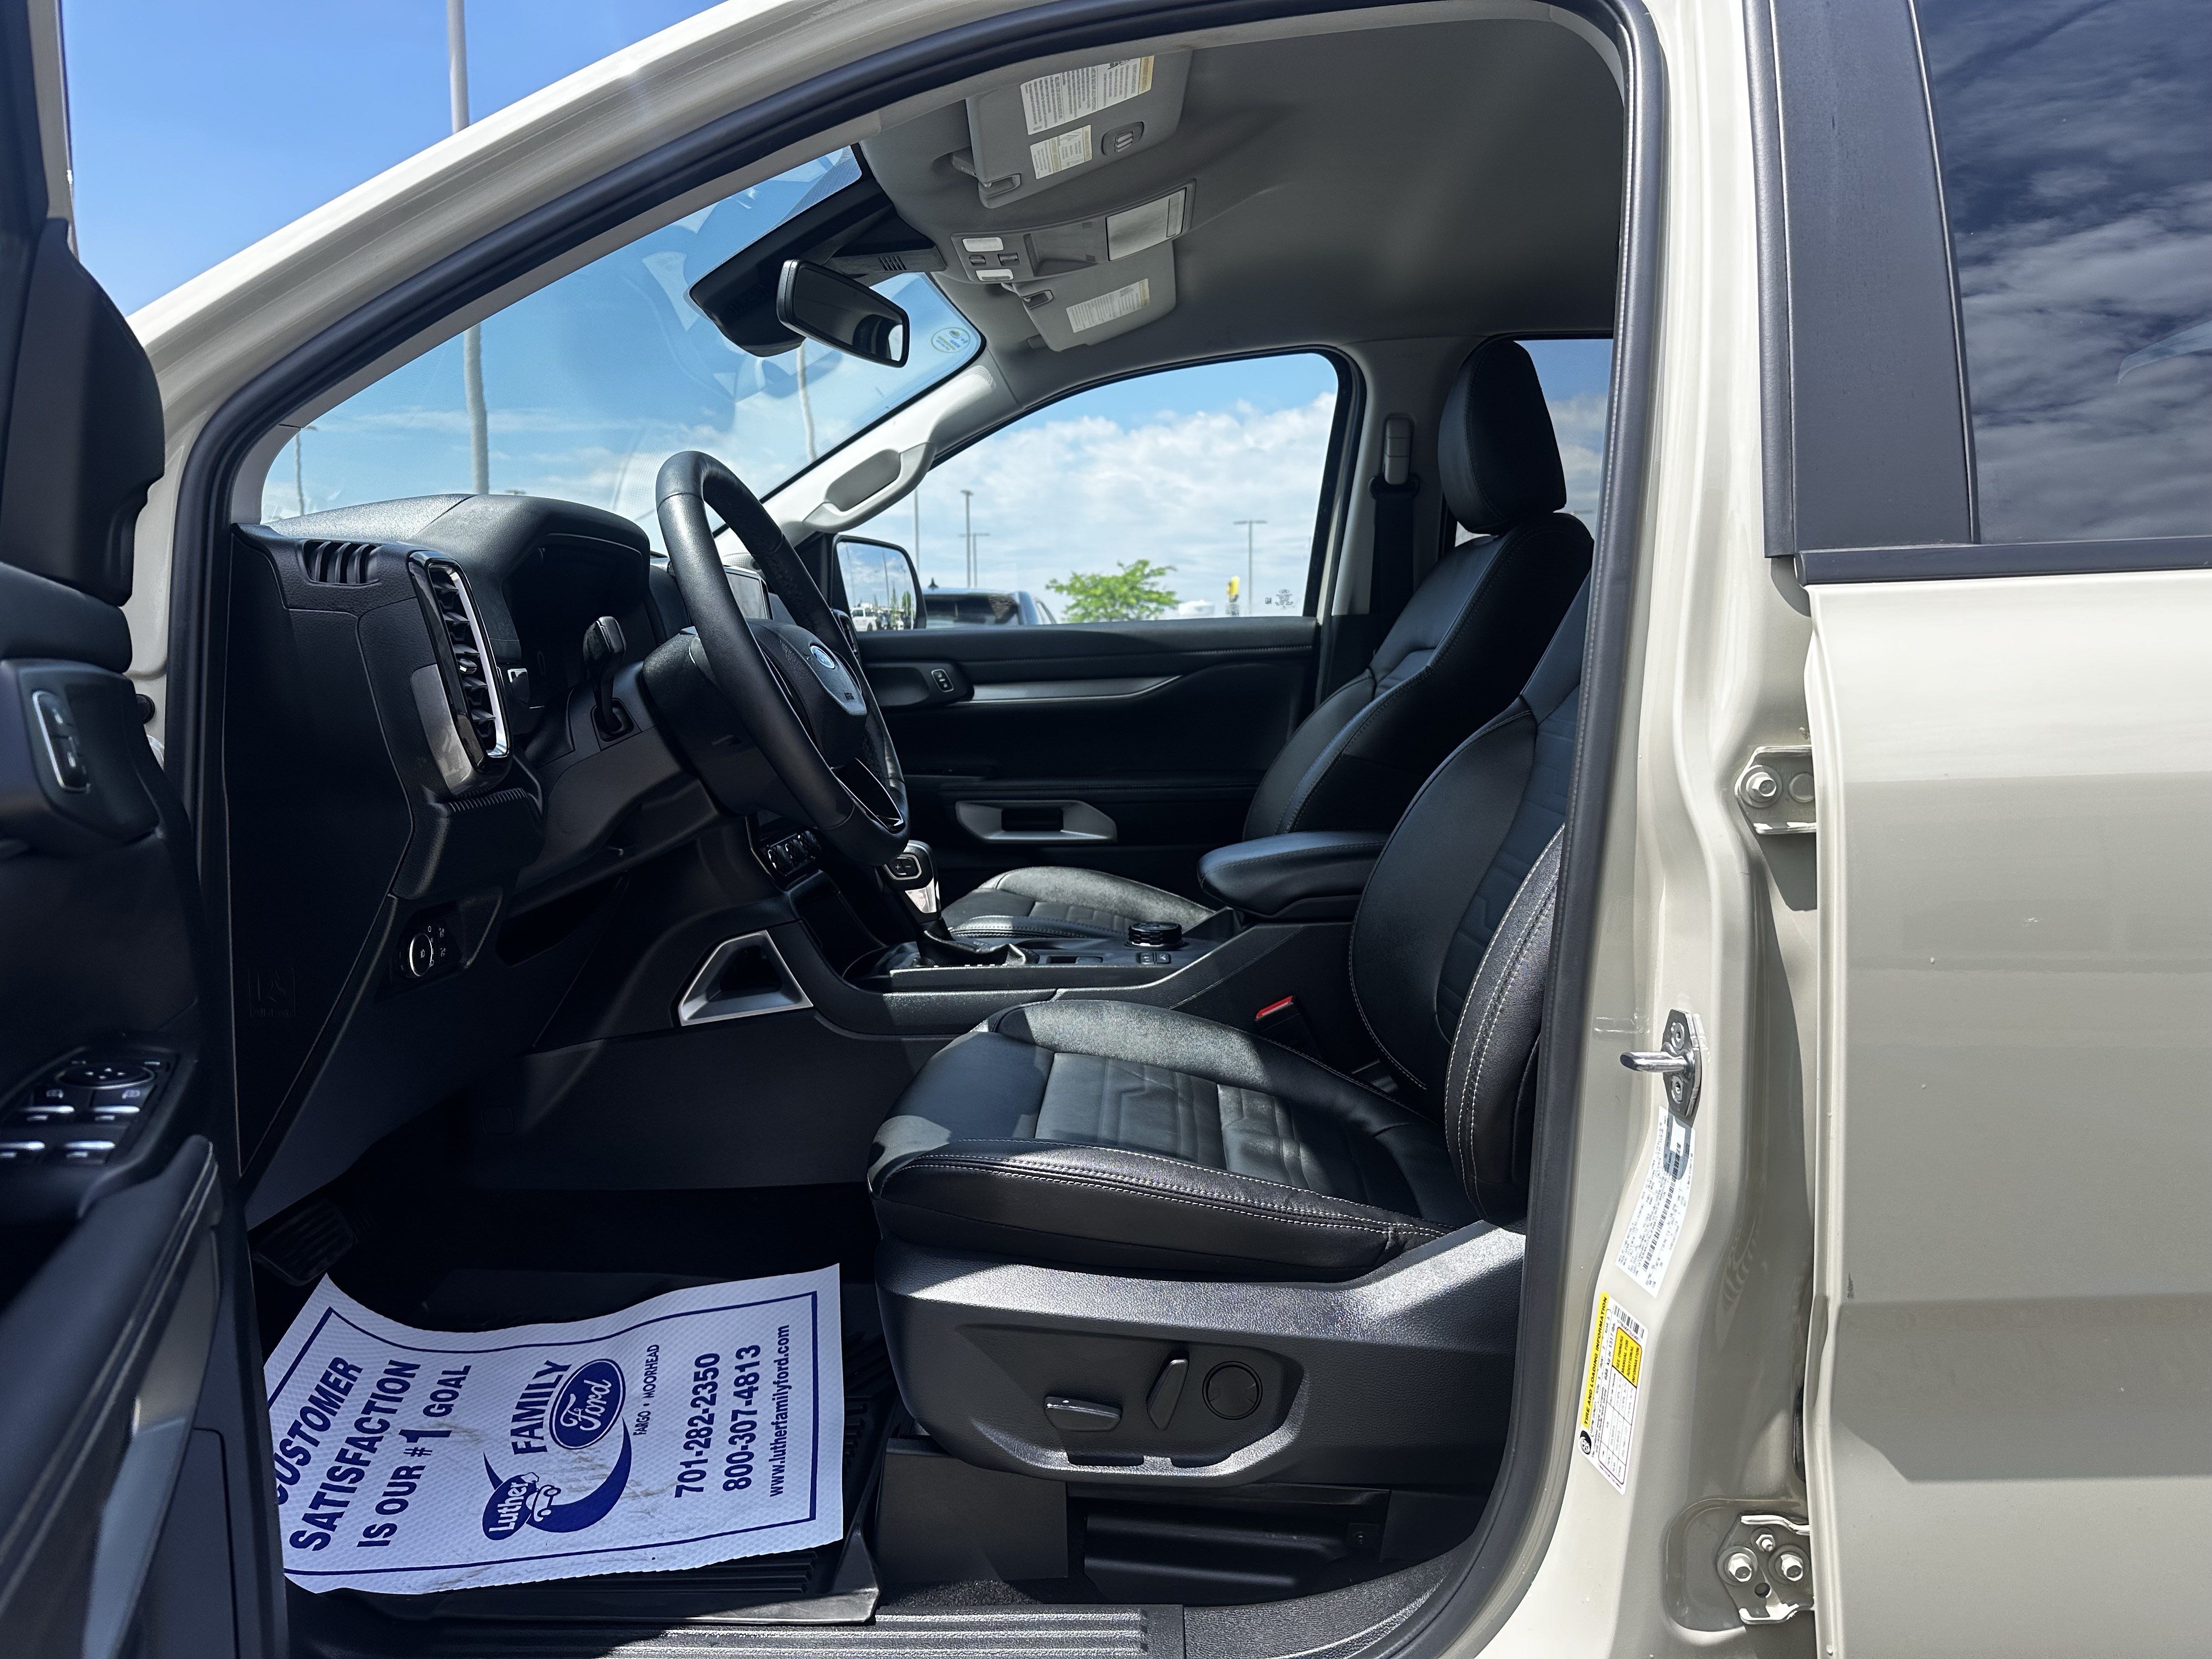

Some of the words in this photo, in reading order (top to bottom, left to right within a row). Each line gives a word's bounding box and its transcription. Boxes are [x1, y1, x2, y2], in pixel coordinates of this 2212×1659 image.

[1595, 1296, 1607, 1351] INFORMATION
[422, 1365, 471, 1417] GOAL
[633, 1410, 651, 1436] FARGO
[642, 1344, 659, 1398] MOORHEAD
[1631, 1346, 1639, 1383] INFORMATION
[510, 1359, 572, 1454] FAMILY
[560, 1379, 612, 1431] Ford
[674, 1352, 720, 1498] 701-282-2350
[722, 1345, 760, 1491] 800-307-4813
[769, 1325, 792, 1497] www.lutherfamilyford.com
[289, 1359, 421, 1551] SATISFACTION
[398, 1429, 452, 1457] #1
[375, 1465, 426, 1515] OUR
[488, 1481, 533, 1532] Luther
[357, 1522, 397, 1547] IS
